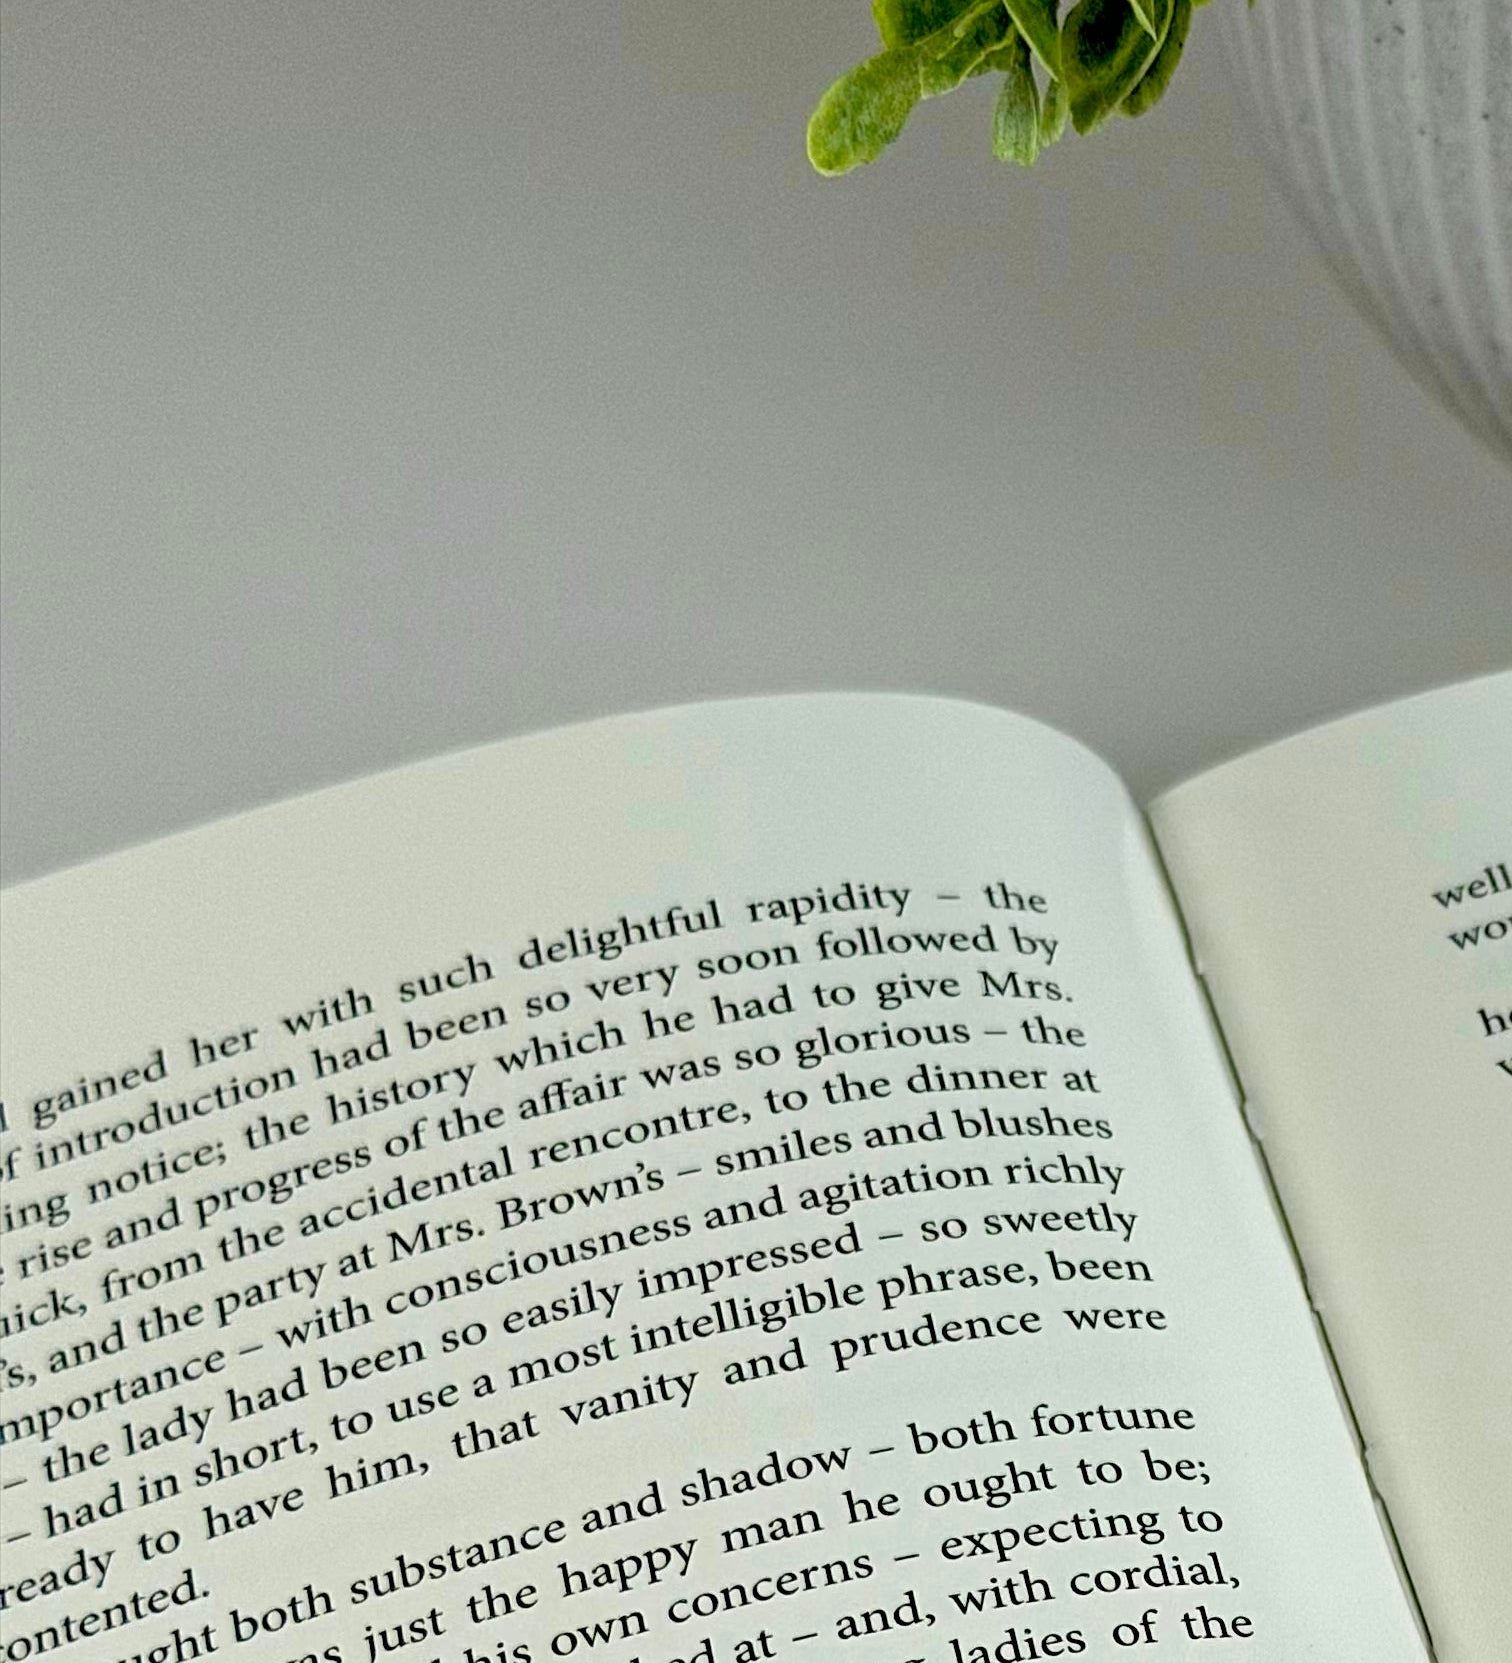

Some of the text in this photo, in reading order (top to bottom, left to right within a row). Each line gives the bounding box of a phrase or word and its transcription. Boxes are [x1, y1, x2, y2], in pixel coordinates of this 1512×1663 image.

[32, 1048, 168, 1131] gained
[188, 1027, 259, 1068] her
[280, 987, 375, 1037] with
[398, 952, 495, 1004] such
[517, 898, 725, 970] delightful
[745, 881, 911, 927] rapidity
[983, 881, 1048, 914] the
[86, 1141, 227, 1205] notice;
[242, 1113, 311, 1151] the
[324, 1062, 477, 1126] history
[492, 1018, 627, 1075] which
[640, 1007, 696, 1041] he
[709, 982, 796, 1026] had
[811, 983, 856, 1009] to
[875, 971, 961, 1011] give
[976, 969, 1073, 1003] Mrs.
[41, 1480, 128, 1539] had
[137, 1474, 182, 1507] in
[194, 1426, 319, 1488] short,
[328, 1410, 374, 1442] to
[385, 1383, 460, 1423] use
[472, 1373, 497, 1399] a
[507, 1333, 620, 1389] most
[629, 1276, 866, 1355] intelligible
[875, 1262, 1039, 1312] phrase,
[1044, 1249, 1155, 1282] been
[1112, 1608, 1159, 1647] of
[1179, 1604, 1255, 1641] the
